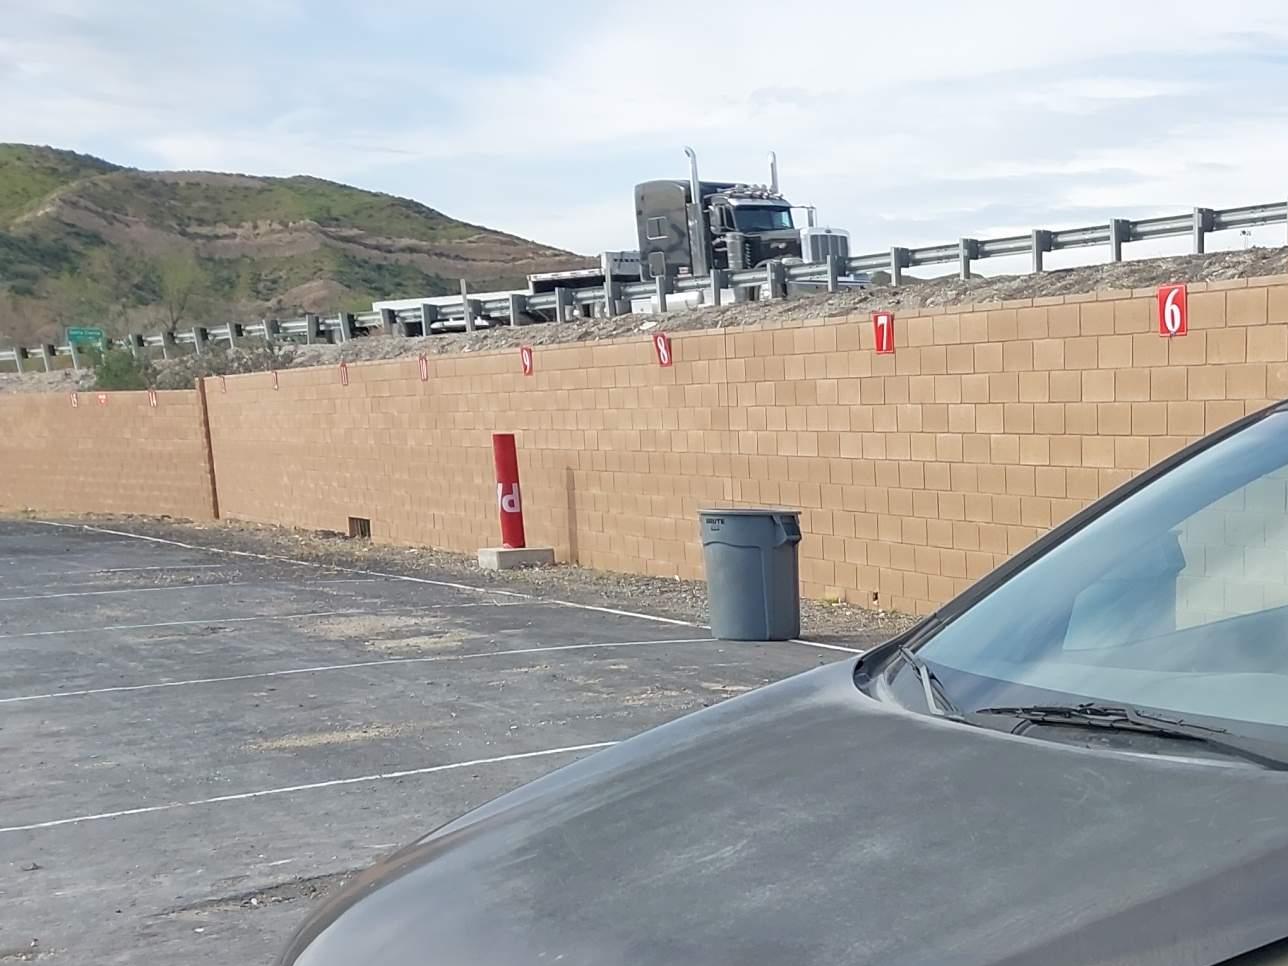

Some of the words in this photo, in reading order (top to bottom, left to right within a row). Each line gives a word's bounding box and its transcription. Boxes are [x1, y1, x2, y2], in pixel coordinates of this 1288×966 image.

[1164, 288, 1181, 335] 6
[878, 315, 888, 349] 7
[523, 349, 530, 374] 9
[657, 336, 668, 364] 8
